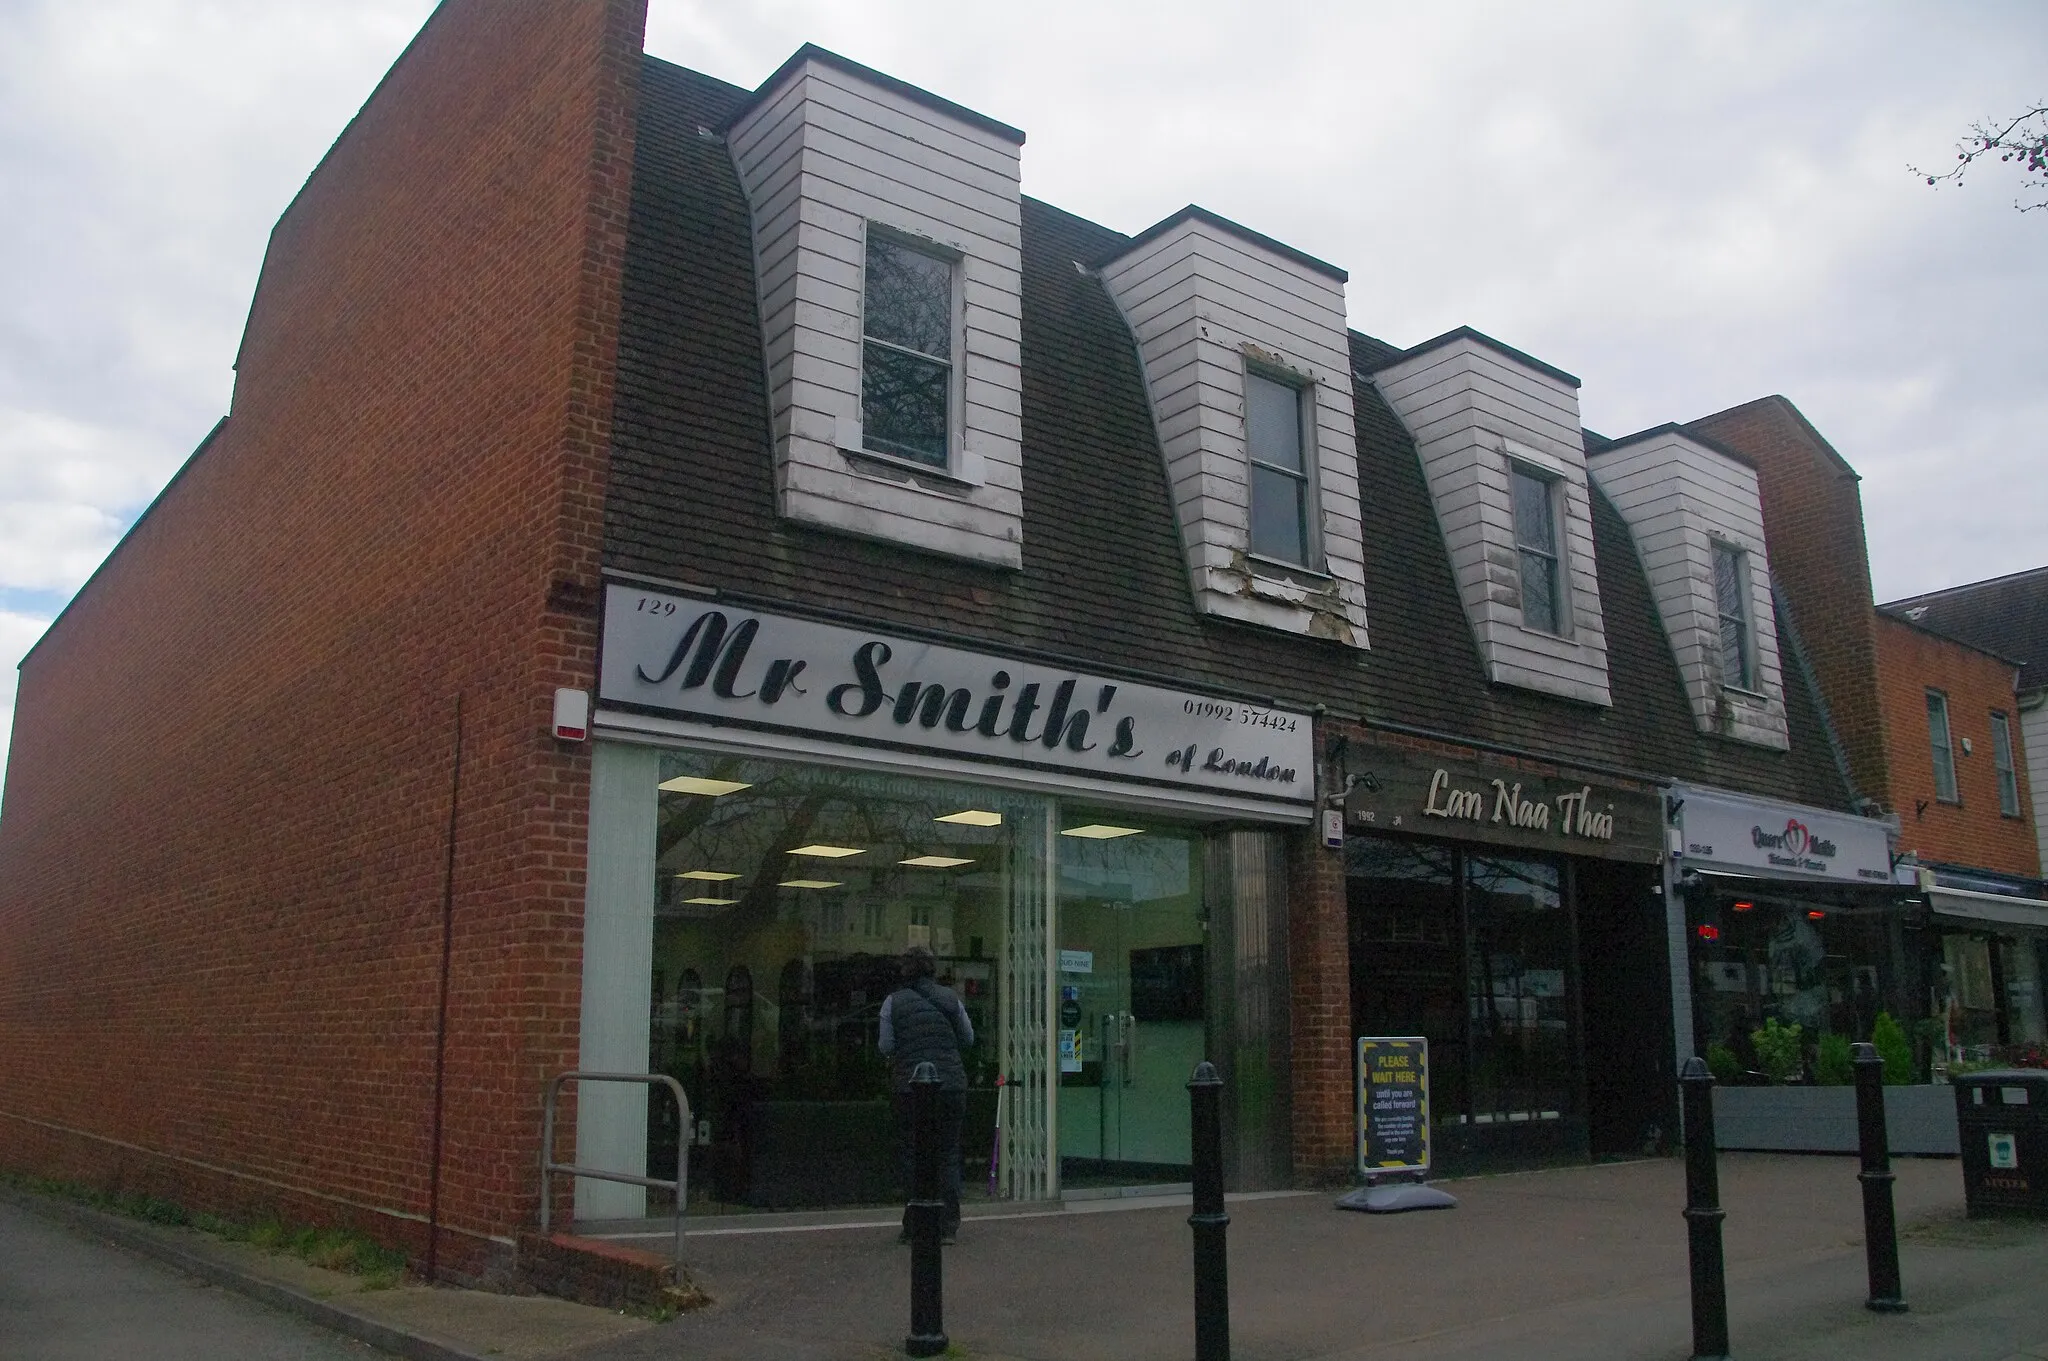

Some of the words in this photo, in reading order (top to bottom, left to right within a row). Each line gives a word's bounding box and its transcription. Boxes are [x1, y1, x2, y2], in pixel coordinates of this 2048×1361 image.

[637, 598, 676, 617] 129
[636, 611, 807, 704] Mr
[826, 641, 1143, 758] Smith's
[1184, 699, 1233, 721] 01992
[1240, 710, 1296, 732] 574424
[1165, 743, 1197, 773] of
[1199, 747, 1297, 782] London
[1423, 769, 1482, 821] Lan
[1491, 779, 1549, 831] Naa
[1555, 785, 1614, 840] Thai
[1378, 1055, 1409, 1068] PLEASE
[1372, 1071, 1393, 1083] WAIT
[1395, 1070, 1416, 1083] HERE
[1373, 1100, 1392, 1110] called
[1393, 1099, 1416, 1109] forward
[1391, 1090, 1402, 1100] you
